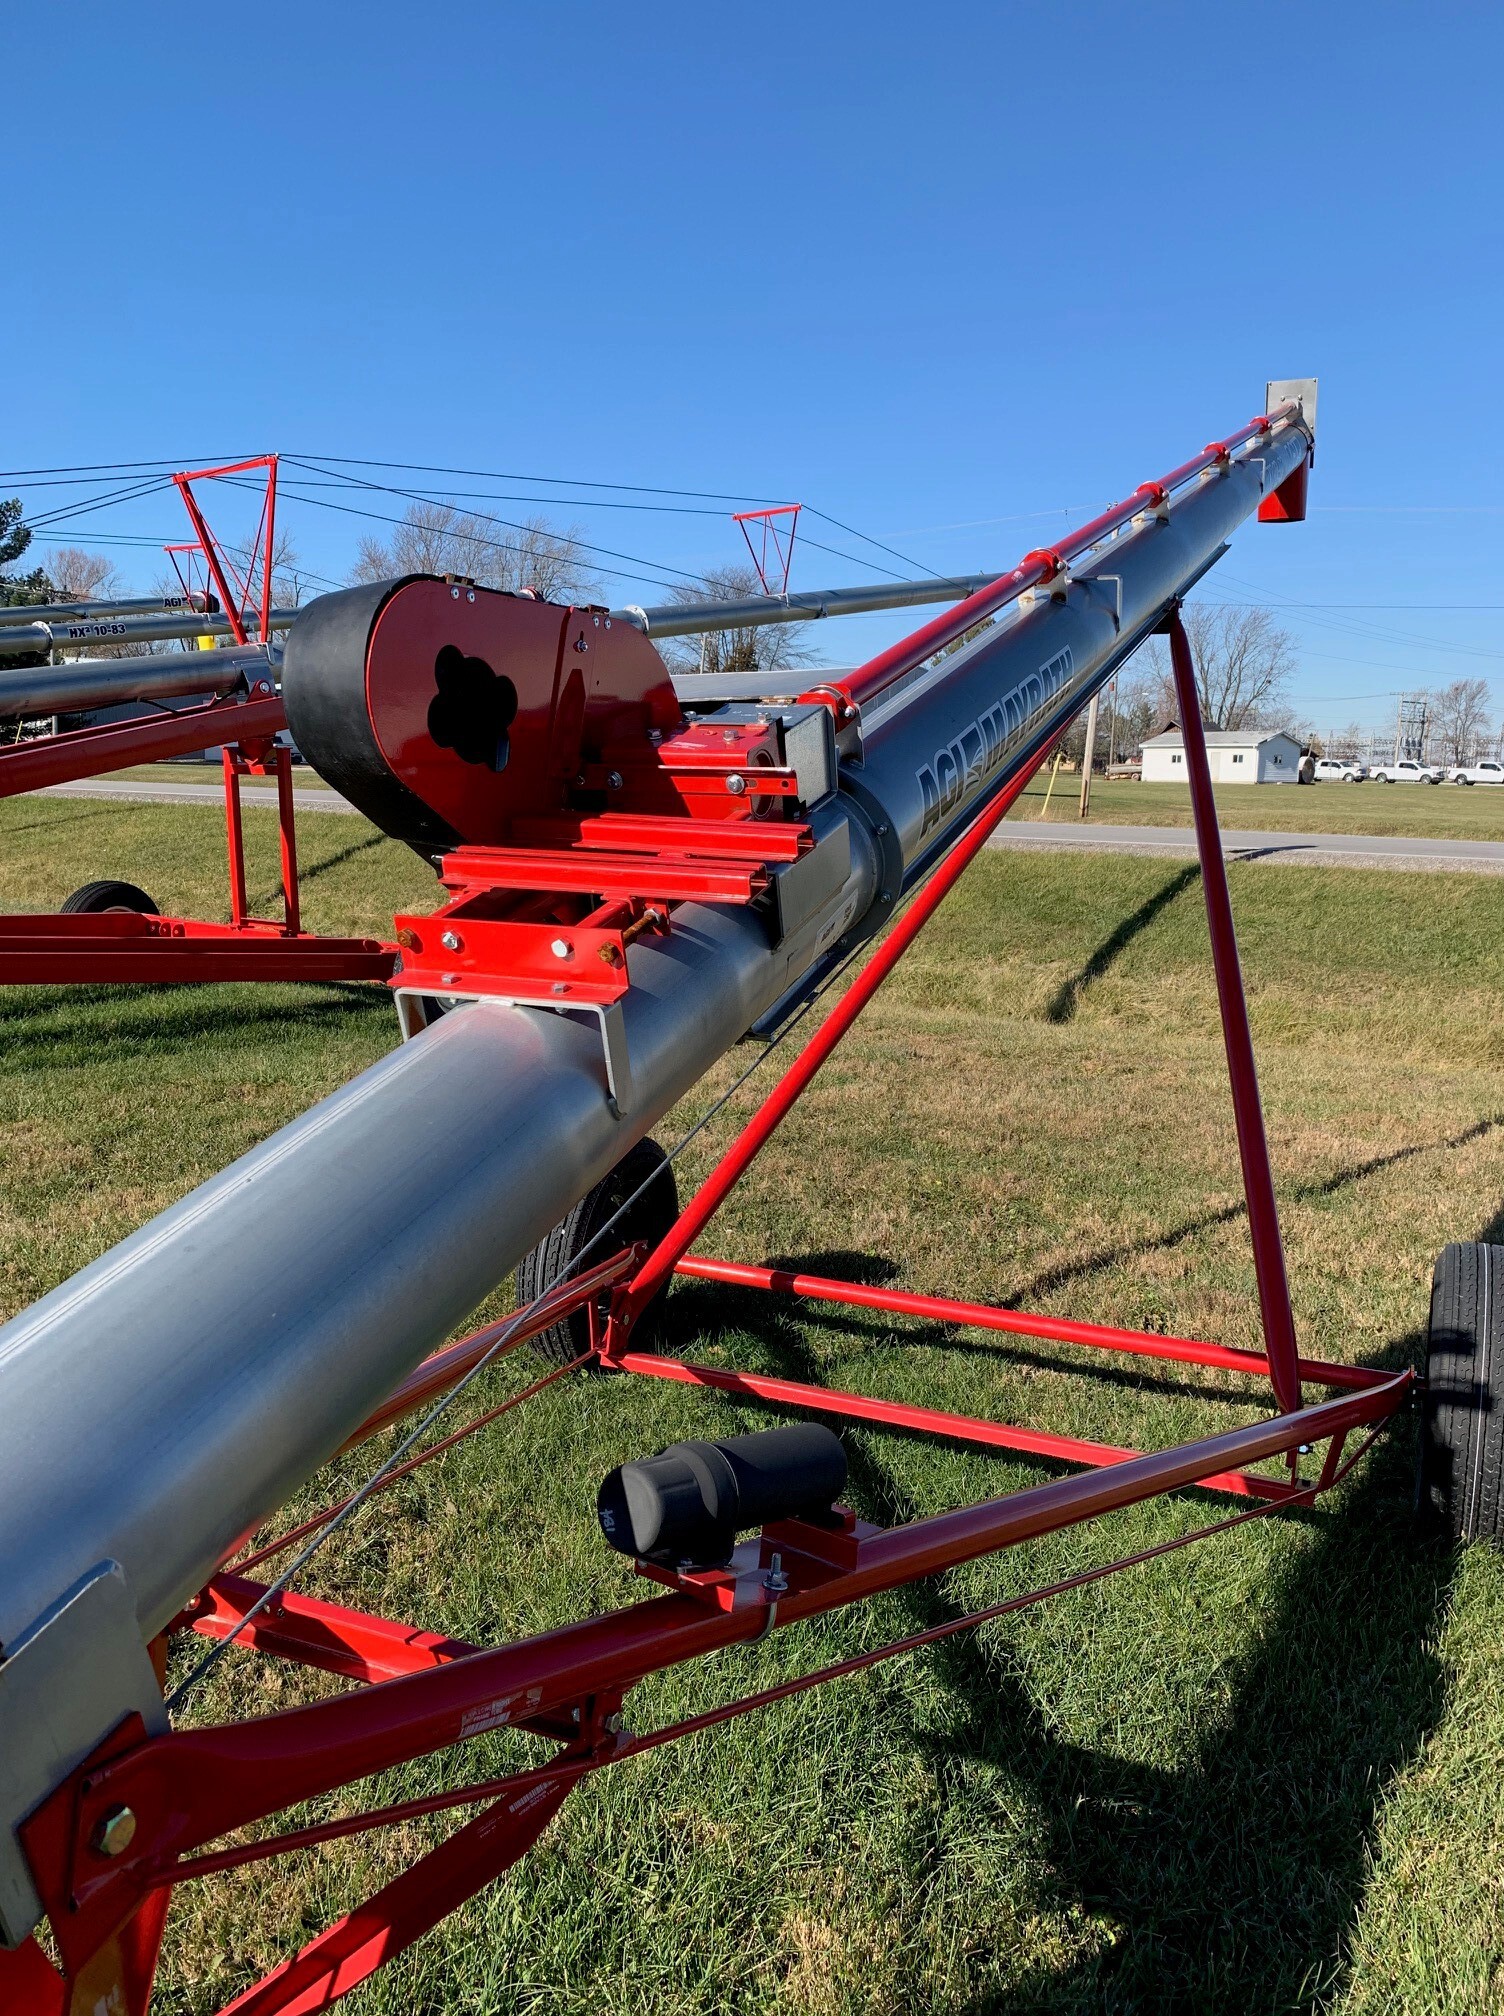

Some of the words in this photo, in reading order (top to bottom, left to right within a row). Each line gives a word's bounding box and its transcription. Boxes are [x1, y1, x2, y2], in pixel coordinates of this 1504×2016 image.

[163, 597, 182, 608] AGI
[94, 624, 126, 636] 10-83
[914, 742, 965, 847] AGI
[978, 644, 1075, 778] MAYRATH
